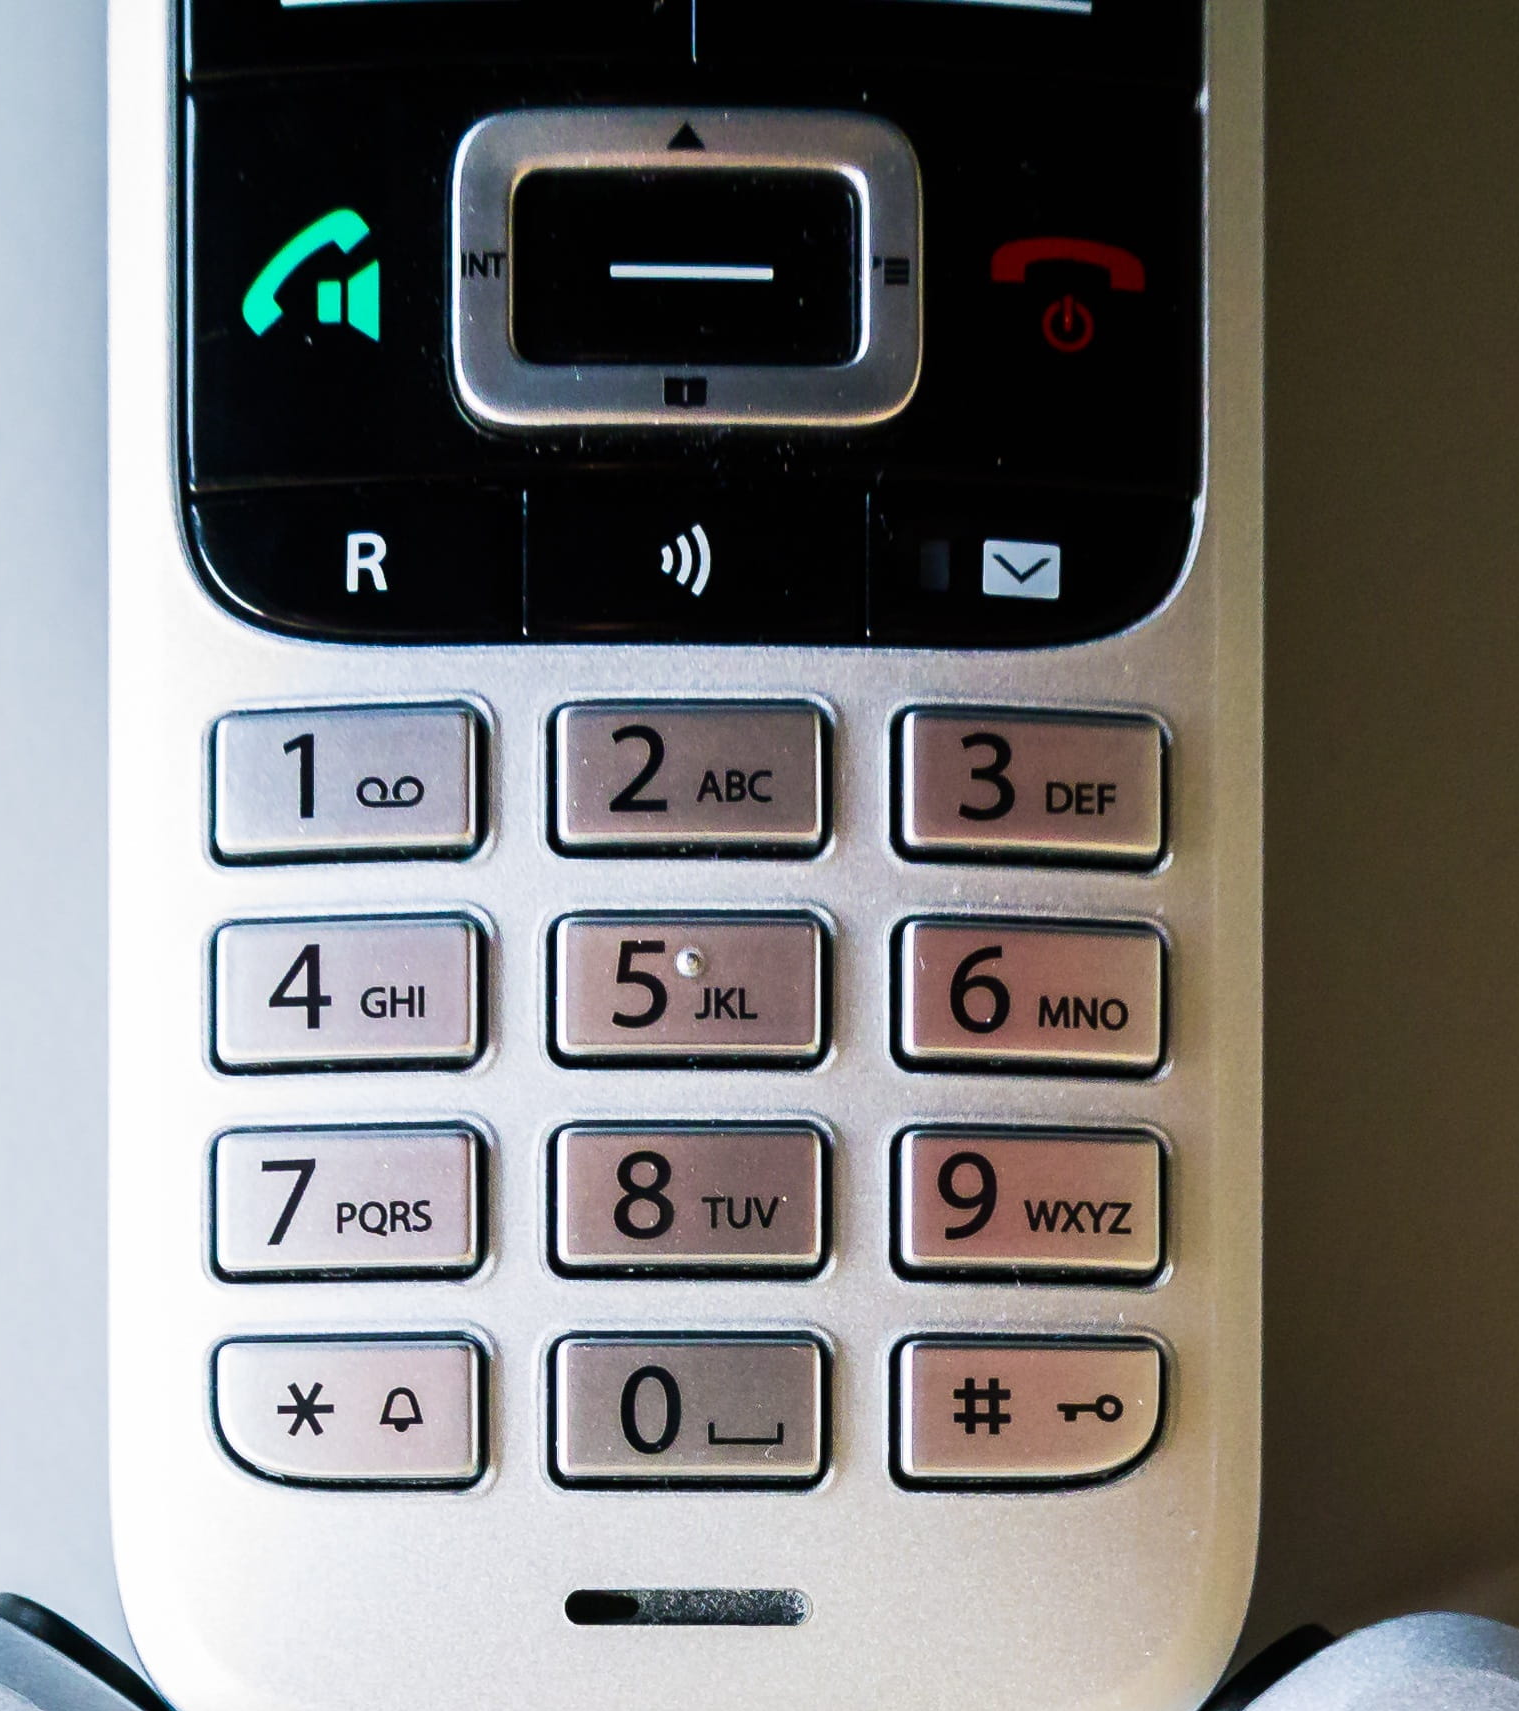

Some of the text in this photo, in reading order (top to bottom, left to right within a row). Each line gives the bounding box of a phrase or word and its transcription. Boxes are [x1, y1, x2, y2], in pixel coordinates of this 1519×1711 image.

[462, 252, 507, 278] INT
[347, 533, 387, 592] R
[284, 734, 314, 818] 1
[610, 725, 772, 812] 2 ABC
[959, 733, 1116, 821] 3 DEF
[269, 944, 424, 1029] 4 GHI
[613, 941, 758, 1028] 5 JKL
[950, 946, 1128, 1033] 6 MNO
[262, 1159, 432, 1245] 7 PQRS
[614, 1151, 779, 1239] 8 TUV
[938, 1152, 1131, 1240] 9 WXYZ
[621, 1366, 681, 1454] 0
